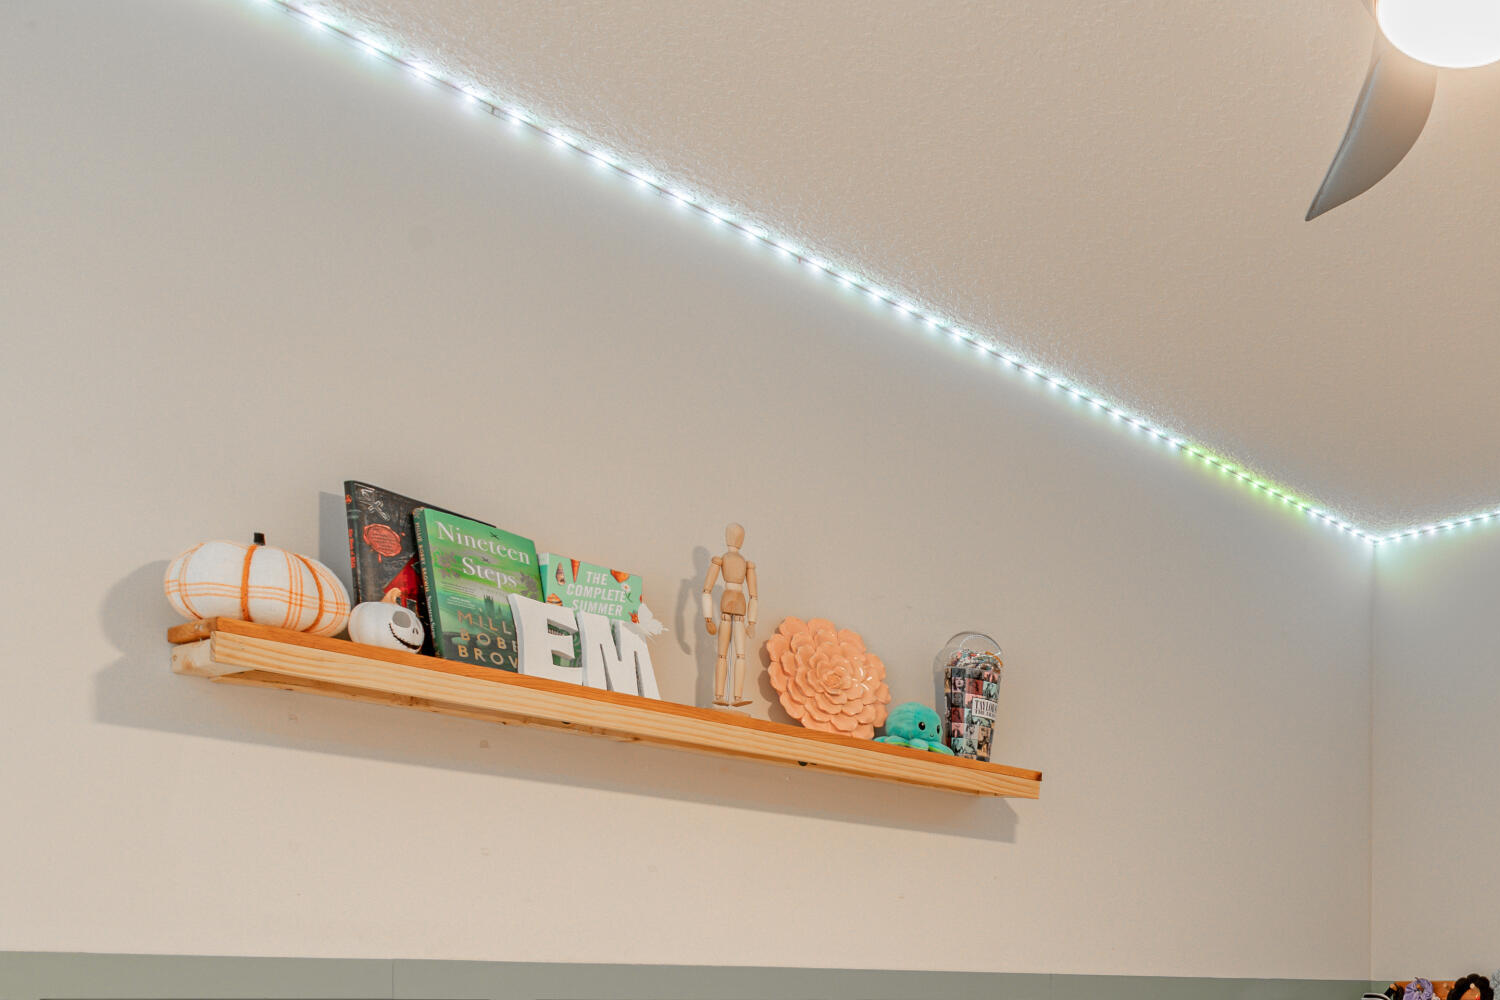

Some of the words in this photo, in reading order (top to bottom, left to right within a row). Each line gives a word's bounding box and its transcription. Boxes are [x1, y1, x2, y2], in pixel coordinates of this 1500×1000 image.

[436, 519, 531, 565] Nineteen
[461, 556, 518, 588] Steps
[585, 571, 609, 586] THE
[566, 583, 626, 603] COMPLETE
[572, 599, 623, 617] SUMMER
